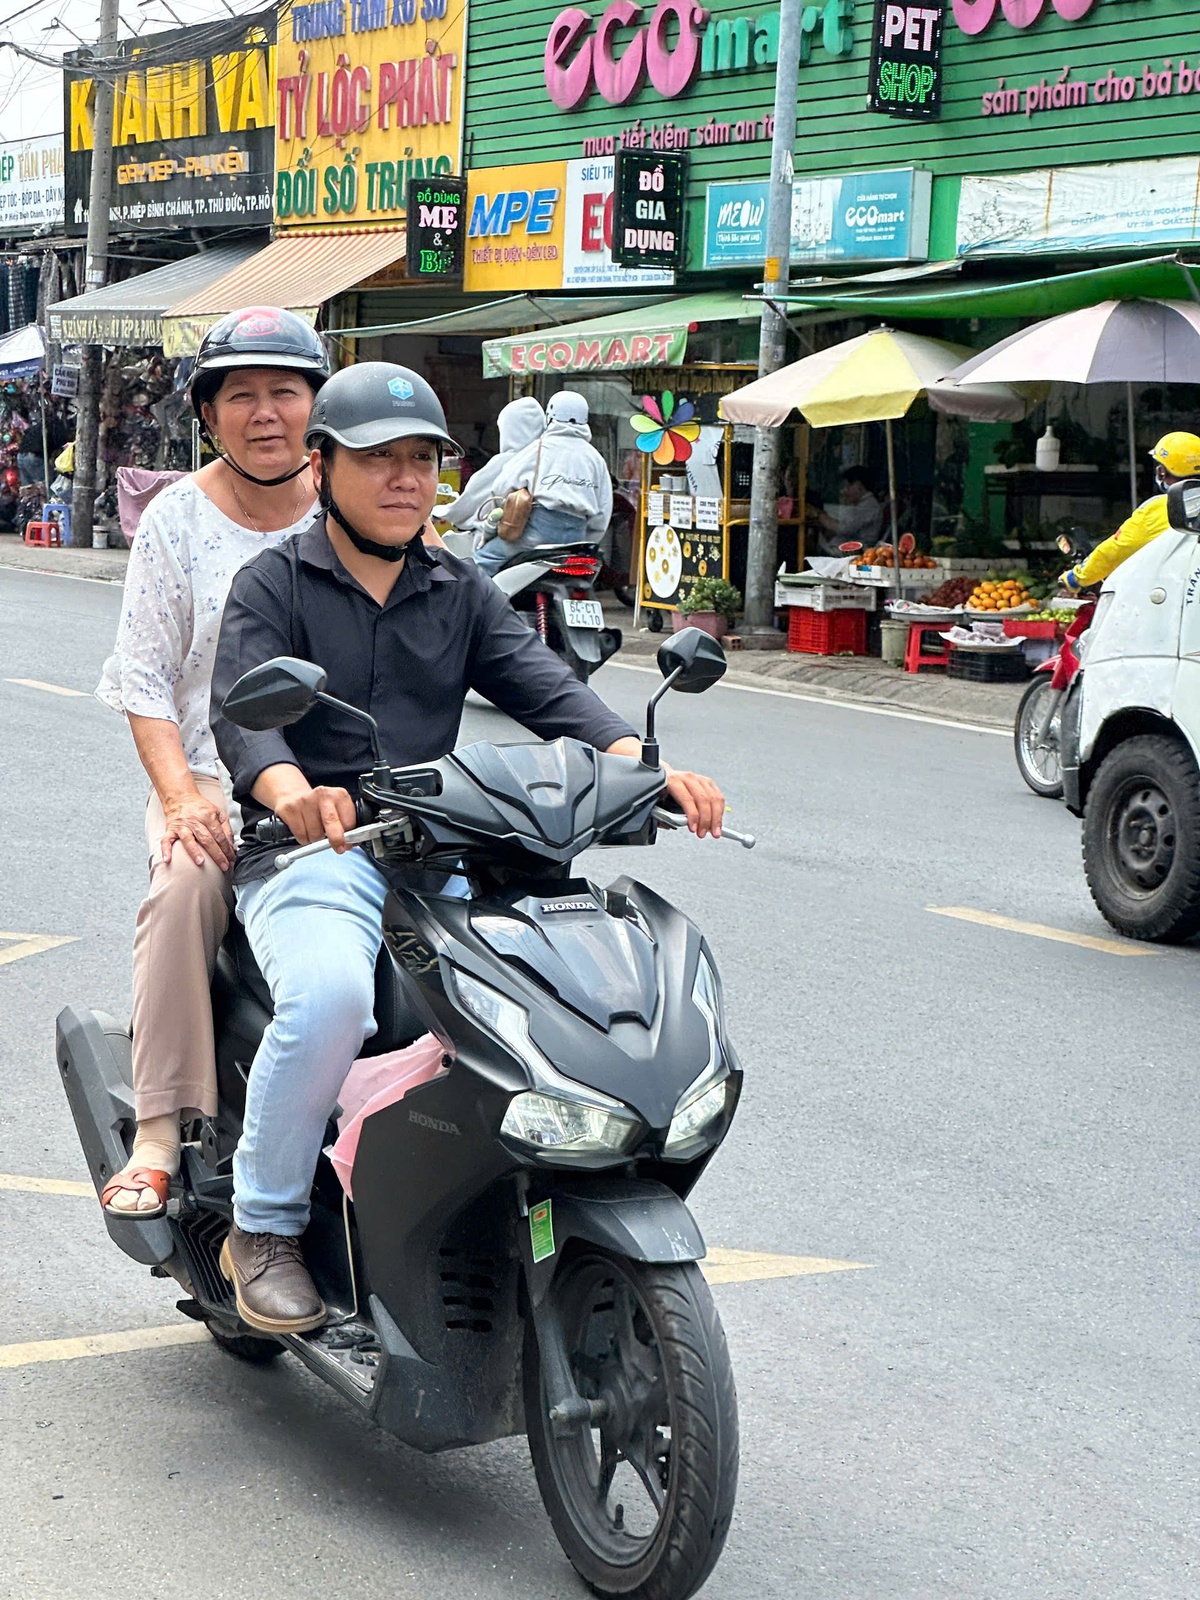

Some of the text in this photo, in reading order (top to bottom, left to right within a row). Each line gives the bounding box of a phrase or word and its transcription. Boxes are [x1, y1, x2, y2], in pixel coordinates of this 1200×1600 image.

[884, 4, 938, 51] PET
[277, 39, 457, 149] TỶ LỘC PHÁT
[878, 60, 933, 104] SHOP
[982, 77, 1020, 116] sản
[1025, 65, 1089, 118] phẩm
[1093, 69, 1135, 101] cho
[71, 48, 207, 152] KÁNH
[583, 133, 615, 156] mua
[619, 119, 647, 149] tiết
[735, 120, 758, 142] an
[323, 147, 359, 215] SỐ
[581, 164, 600, 181] SIÊU
[638, 164, 664, 192] ĐỒ
[208, 191, 225, 213] THỦ
[467, 188, 560, 238] MPE
[635, 199, 666, 221] GIA
[717, 197, 765, 228] MEOW
[845, 205, 905, 228] ecomart
[418, 204, 458, 236] MẸ
[433, 232, 443, 246] &
[624, 228, 675, 254] DỤNG
[510, 334, 675, 371] ECOMART
[569, 614, 601, 626] 244.10
[542, 902, 598, 913] HONDA
[408, 1110, 461, 1136] HONDA
